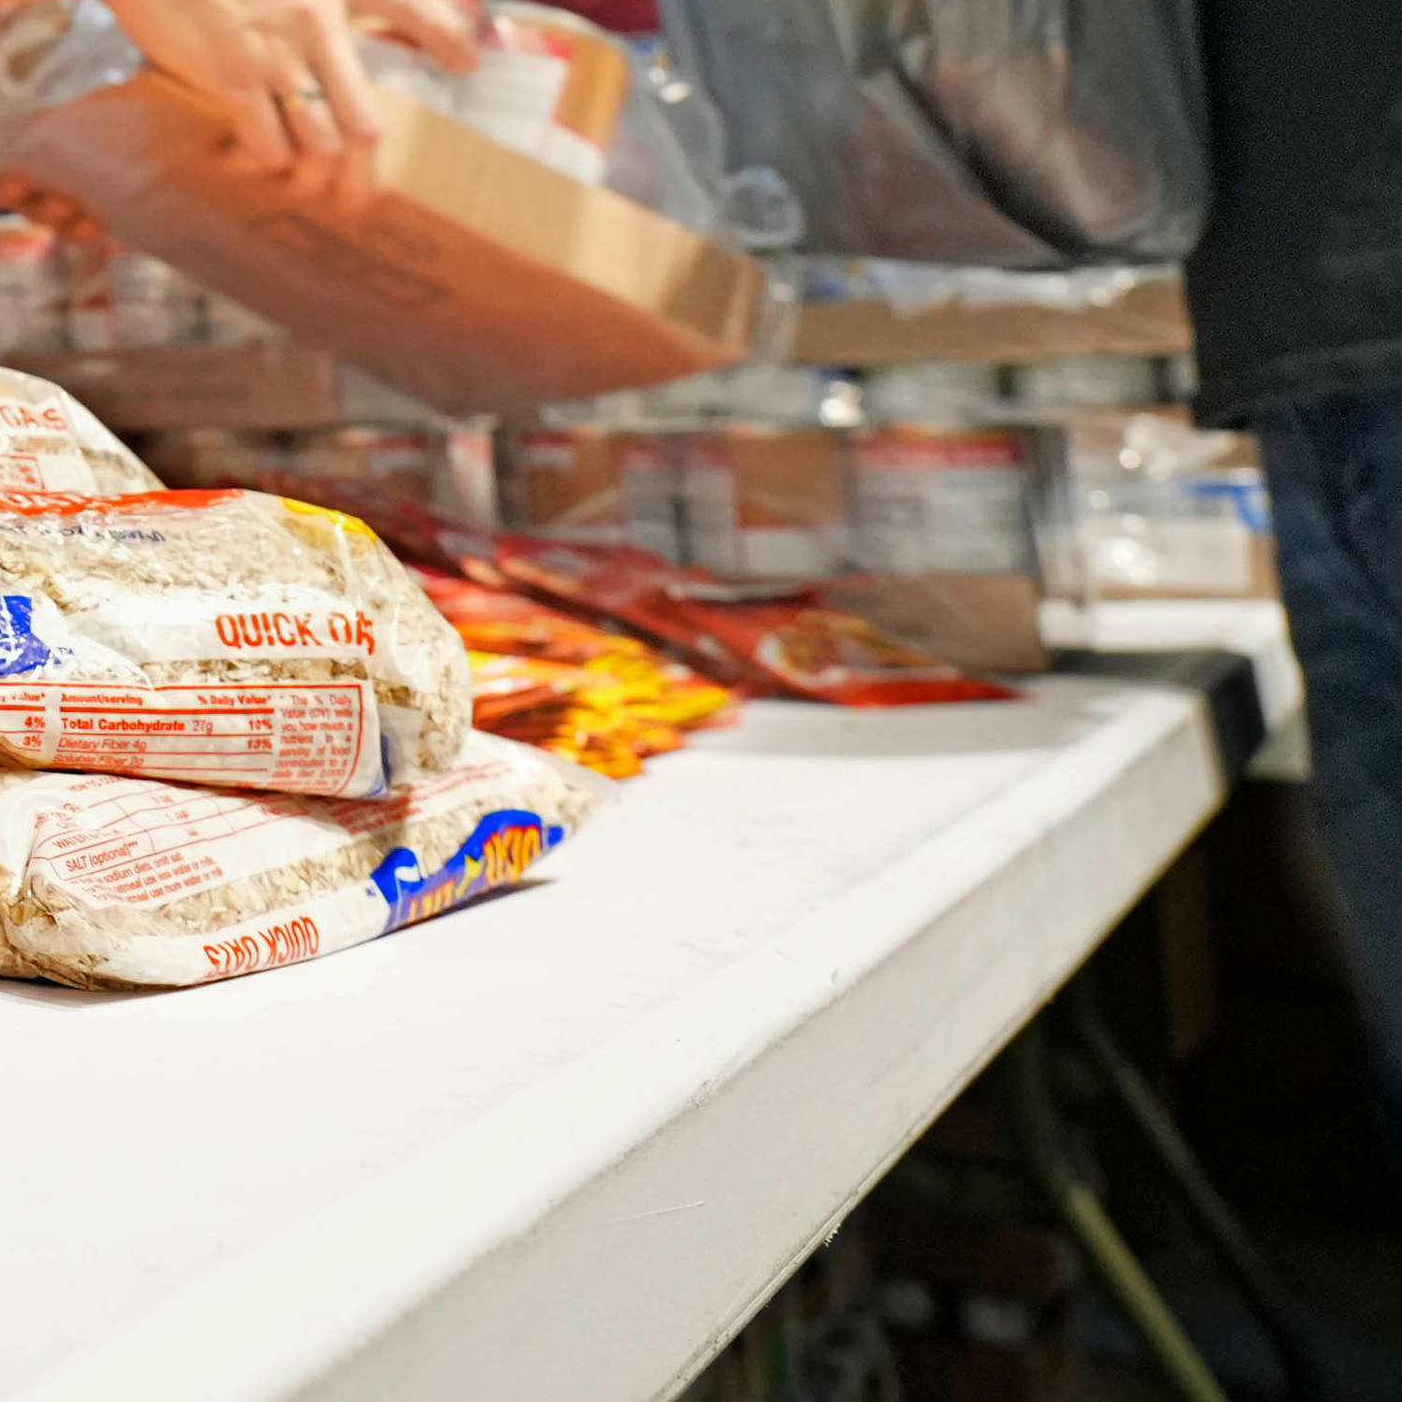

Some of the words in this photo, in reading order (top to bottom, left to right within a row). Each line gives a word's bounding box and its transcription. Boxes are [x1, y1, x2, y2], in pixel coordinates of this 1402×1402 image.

[215, 612, 320, 650] QUICK
[210, 695, 235, 707] Daily
[24, 716, 45, 728] 4%
[61, 718, 95, 731] Total
[98, 718, 185, 732] Carbohydrate
[248, 718, 273, 731] 10%
[66, 855, 87, 872] SALT
[258, 916, 320, 967] QUICK
[203, 934, 259, 978] OATS
